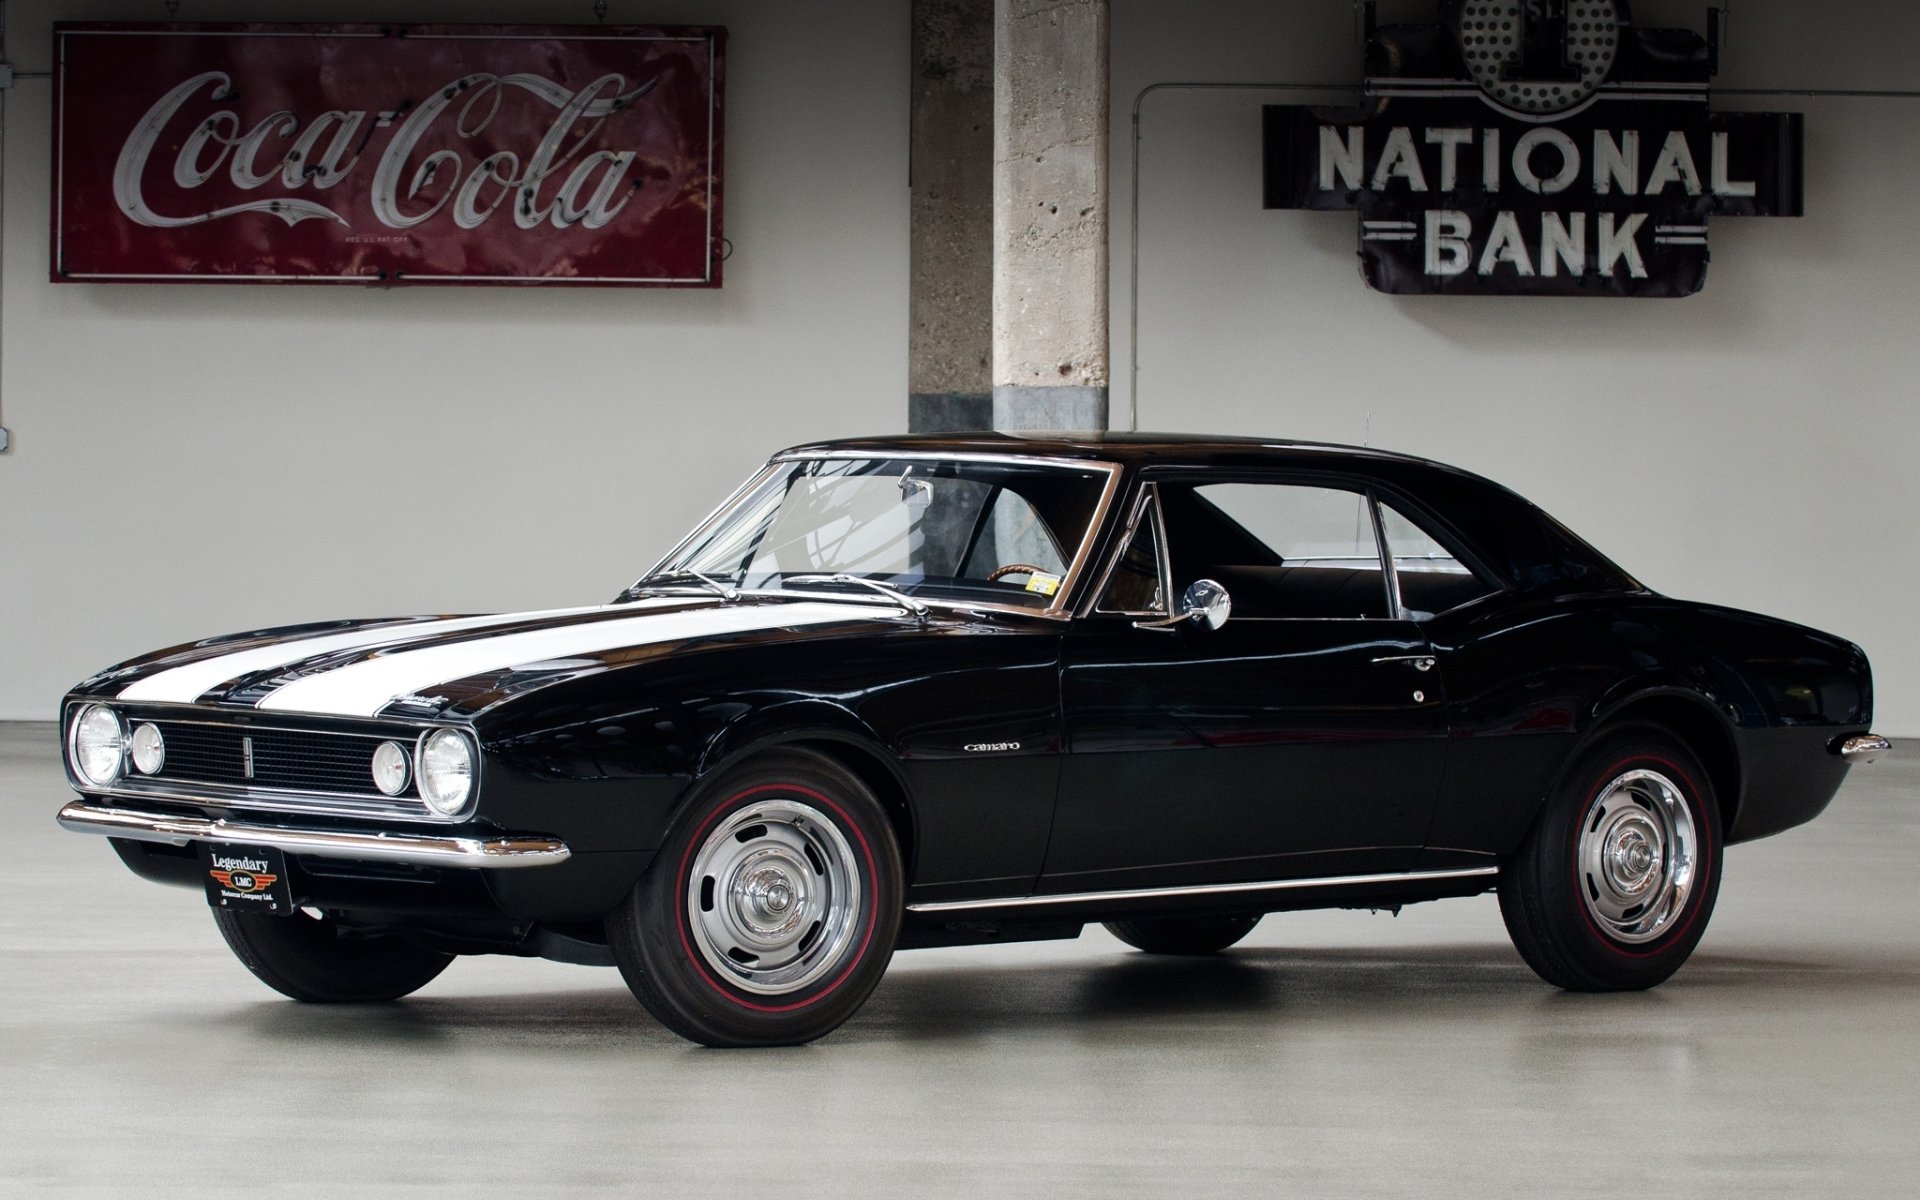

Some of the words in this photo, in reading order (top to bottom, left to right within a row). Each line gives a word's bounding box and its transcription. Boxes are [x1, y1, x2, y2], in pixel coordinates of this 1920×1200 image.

[113, 70, 658, 230] Coca-Cola
[1318, 125, 1757, 197] NATIONAL
[1424, 209, 1649, 279] BANK
[211, 853, 268, 873] Legendary
[234, 876, 252, 887] LMC
[241, 892, 262, 901] Company
